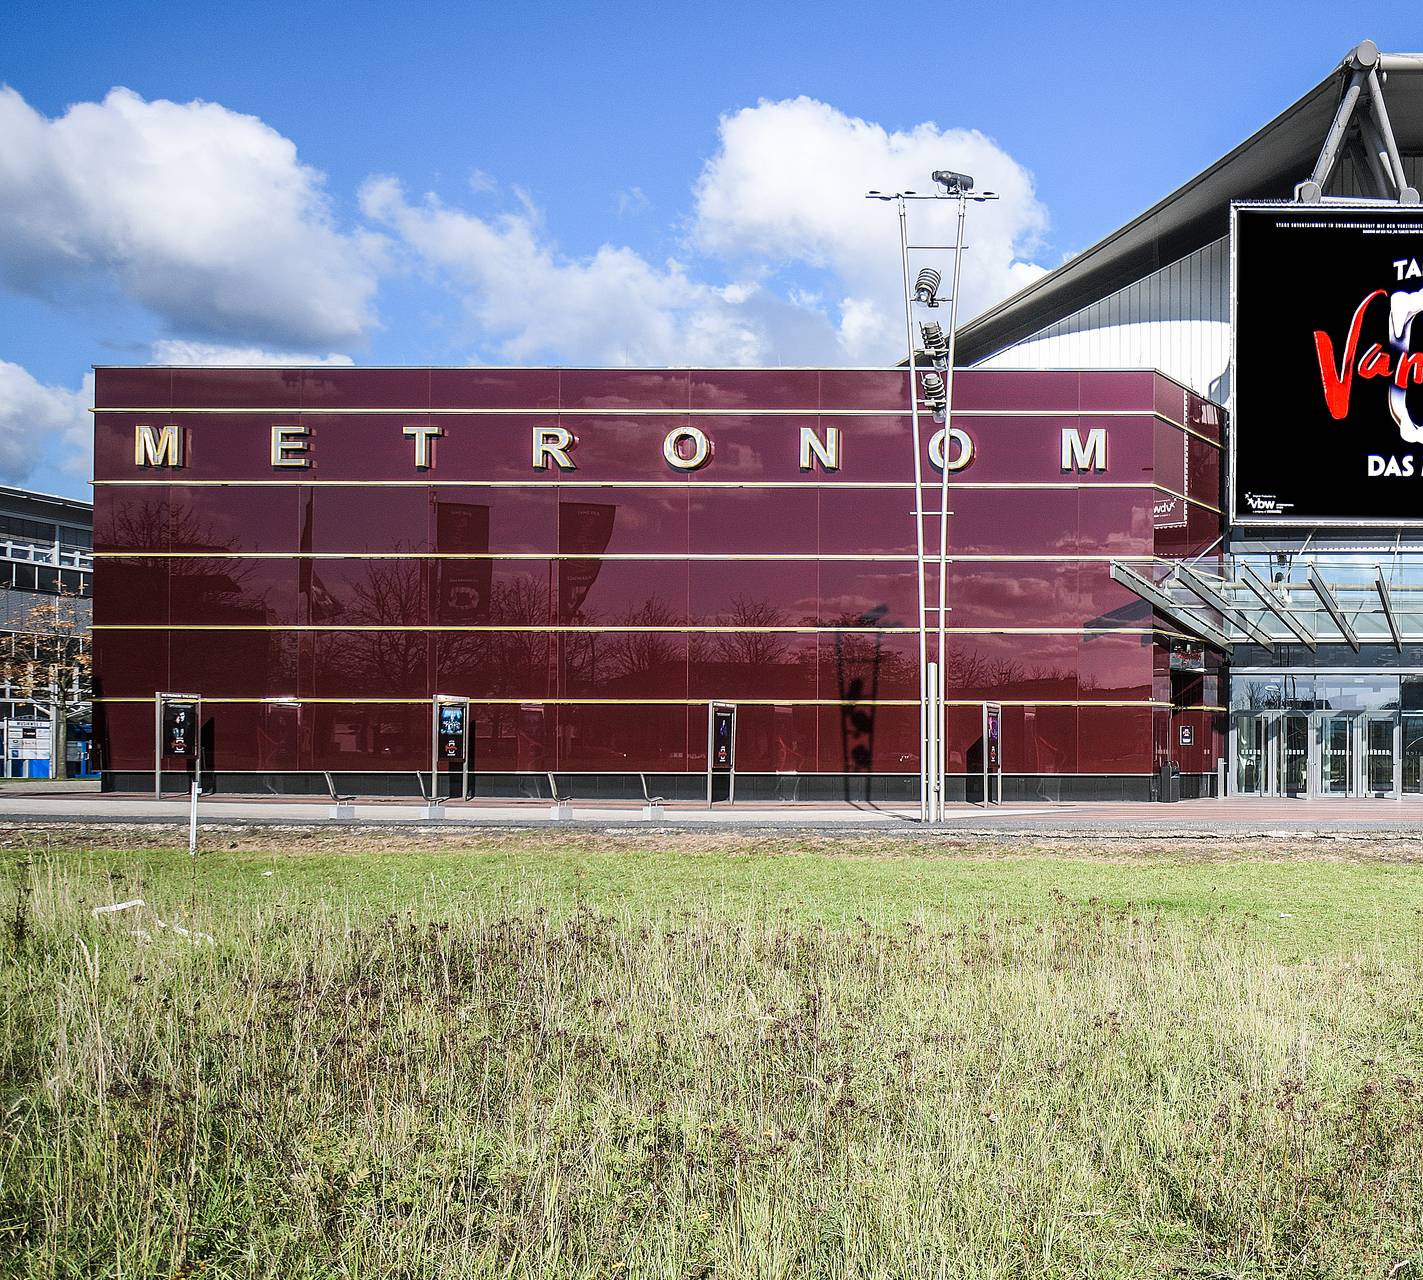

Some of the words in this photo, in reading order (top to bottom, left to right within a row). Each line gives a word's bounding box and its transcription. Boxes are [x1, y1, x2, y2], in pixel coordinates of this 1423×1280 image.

[135, 425, 1107, 471] METRONOM
[1368, 455, 1415, 477] DAS
[1251, 498, 1275, 509] vbw
